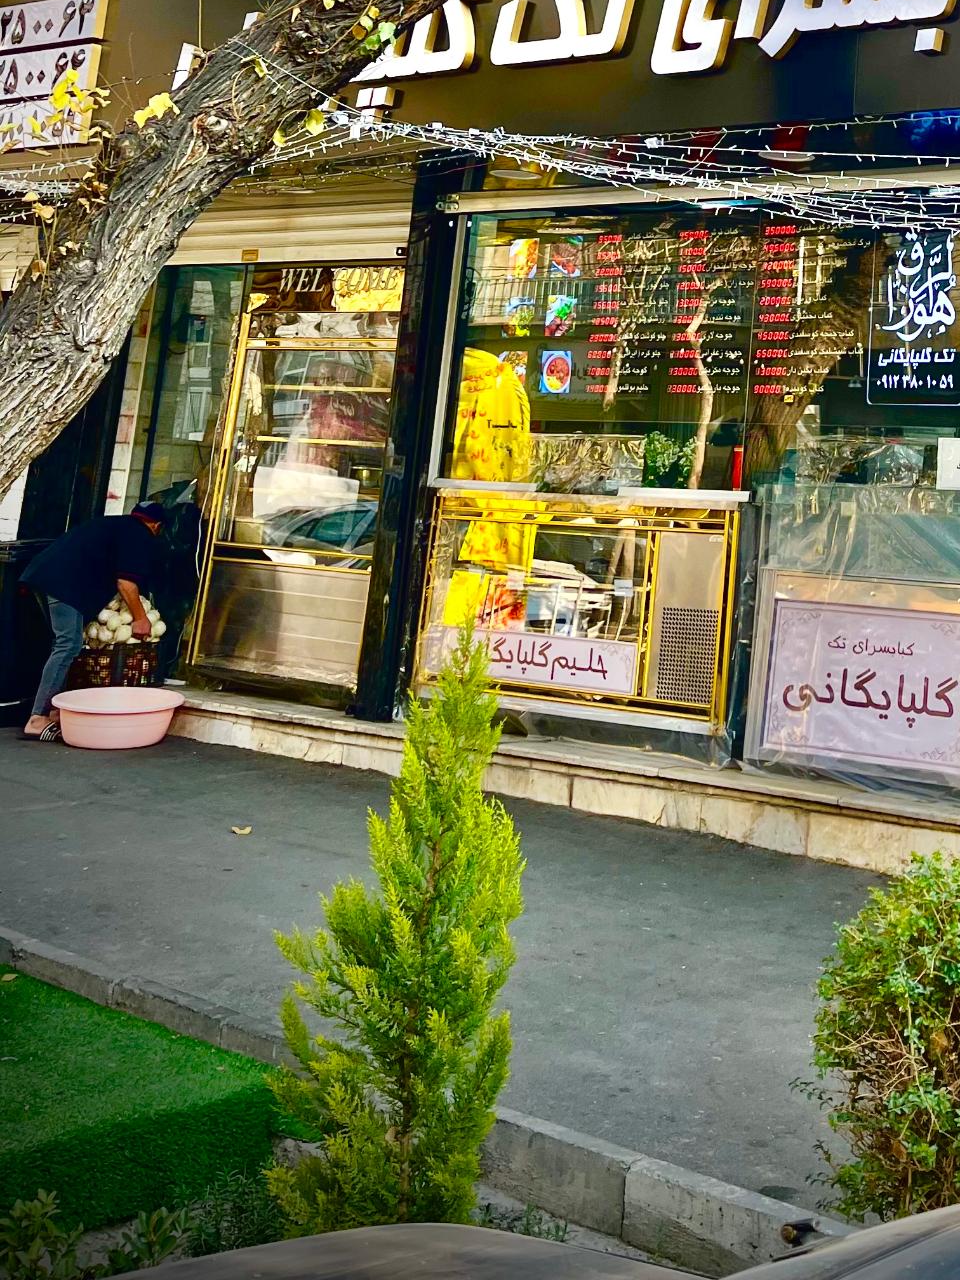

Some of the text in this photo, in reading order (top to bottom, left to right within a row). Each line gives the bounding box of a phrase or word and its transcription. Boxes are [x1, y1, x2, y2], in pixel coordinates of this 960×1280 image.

[878, 347, 955, 369] تک گلپایگانی
[827, 635, 846, 650] تک
[551, 647, 608, 680] حلیم
[783, 668, 959, 728] گلپایگانی
